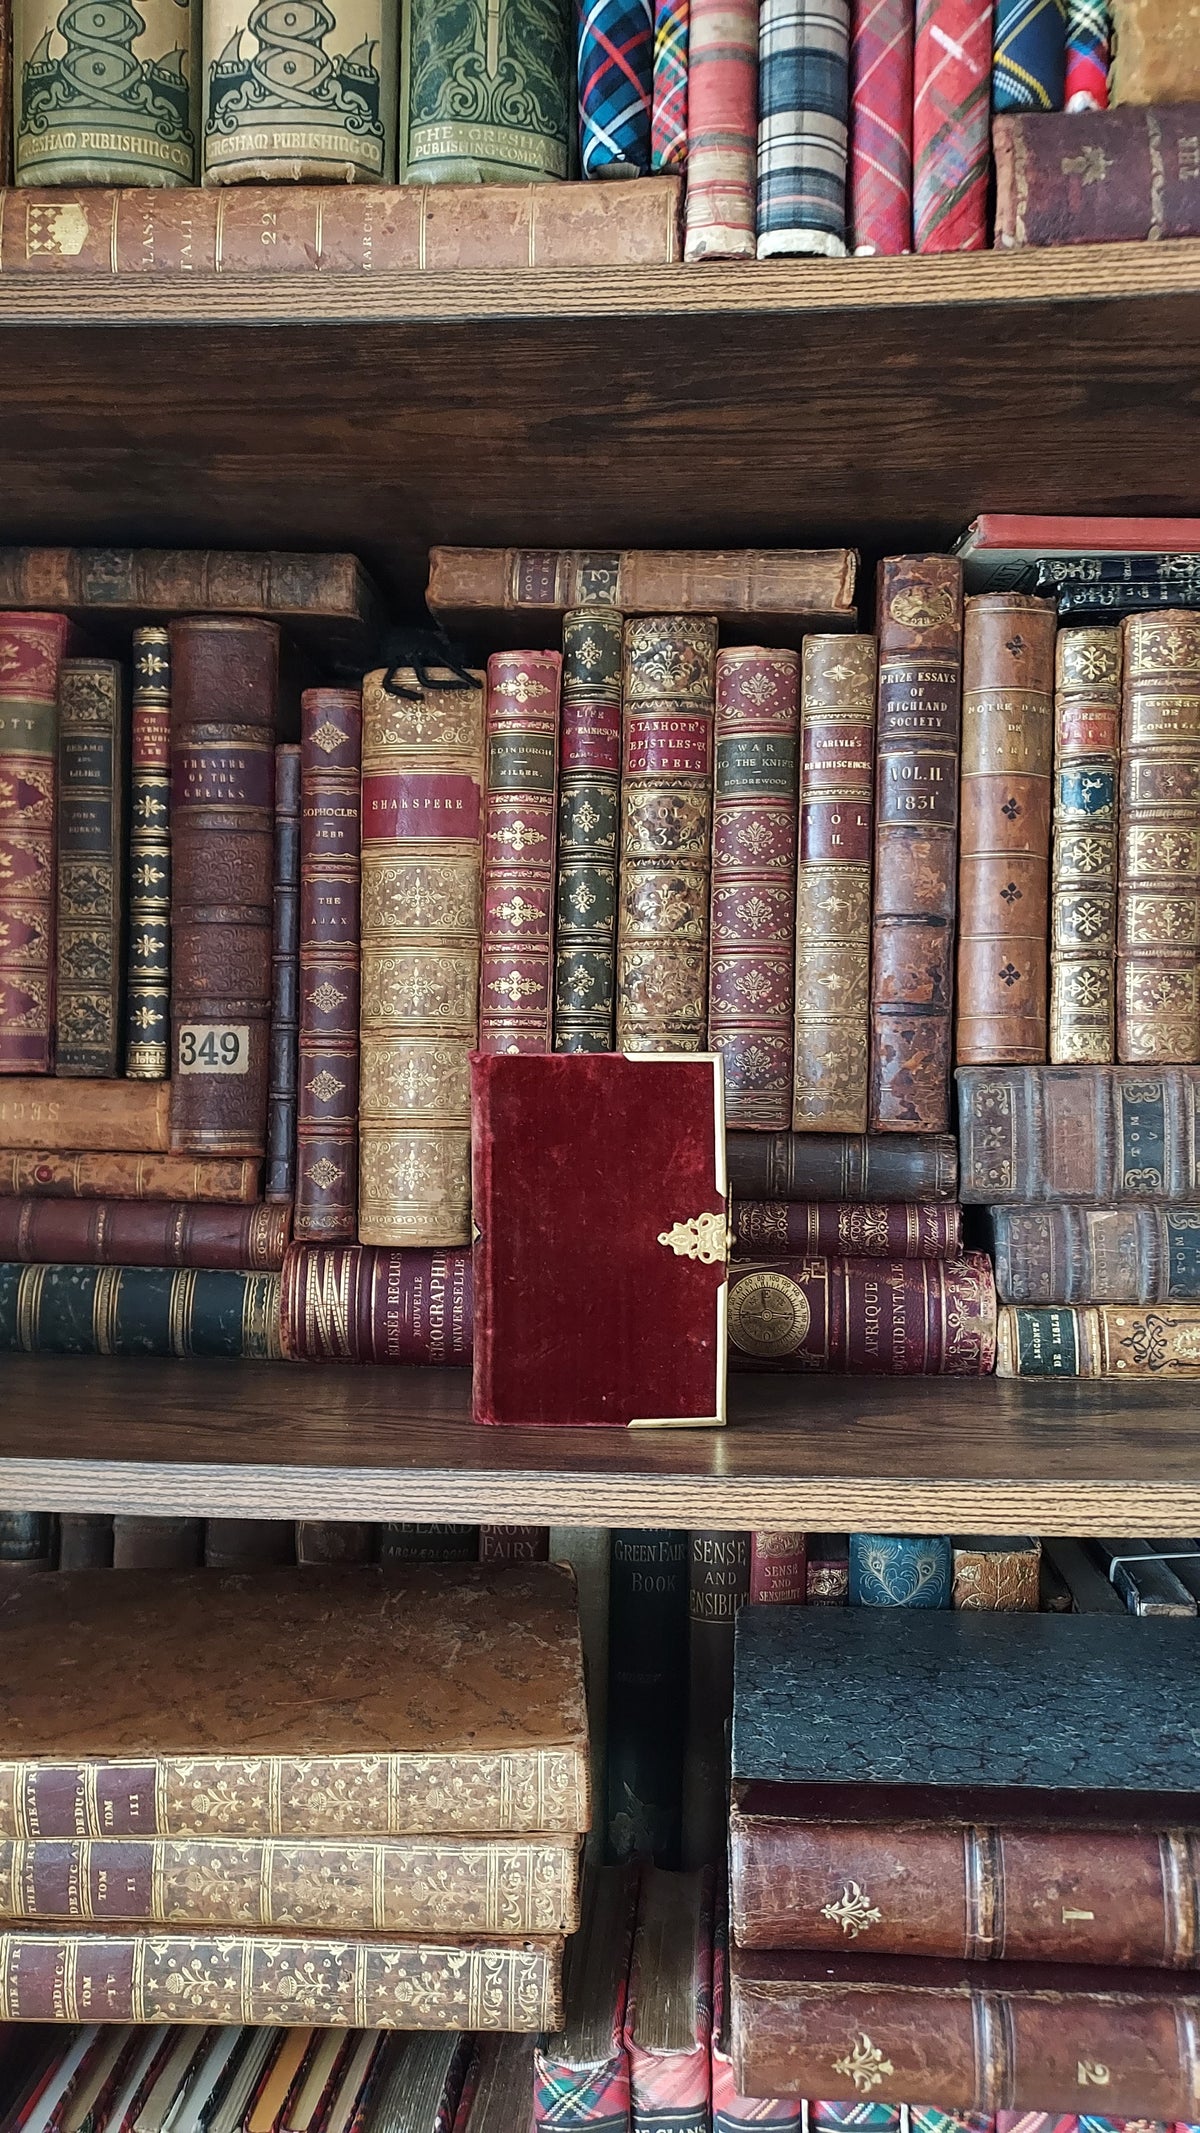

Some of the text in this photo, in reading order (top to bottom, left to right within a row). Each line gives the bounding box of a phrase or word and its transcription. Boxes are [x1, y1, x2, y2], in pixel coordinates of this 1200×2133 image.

[414, 126, 453, 144] THE
[81, 132, 170, 158] PUBLISHING
[272, 132, 361, 154] PUBLISHING
[415, 140, 496, 157] PUBLISHING
[590, 569, 610, 583] 3
[881, 672, 956, 684] PRIZE ESSAYS
[910, 687, 923, 697] OF
[887, 702, 948, 713] HIGHLAND
[968, 702, 1013, 714] NOTRE
[630, 721, 706, 735] STANHOPE'S
[889, 717, 942, 727] SOCIETY
[1008, 724, 1022, 732] DE
[737, 743, 775, 752] WAR
[816, 737, 862, 748] CARLYLE'S
[184, 758, 245, 769] THEATRE
[629, 757, 702, 769] GOSPELS
[735, 758, 757, 767] THE
[211, 773, 235, 783] THE
[724, 778, 787, 786] BOLDREWOOD
[184, 788, 245, 798] GREEKS
[372, 798, 464, 810] SHAKSPERE
[895, 795, 936, 810] 1831
[303, 807, 358, 818] SOPHOCLES
[315, 830, 344, 839] JEBB
[317, 897, 341, 905] THE
[310, 917, 348, 926] AJAX
[180, 1030, 241, 1066] 349
[1130, 1115, 1141, 1158] TOM
[1174, 1236, 1186, 1274] TOM
[384, 1252, 402, 1356] ÉLISÉE RECLUS
[413, 1276, 423, 1337] NOUVELLE
[452, 1258, 465, 1352] UNIVERSELLE
[864, 1282, 881, 1356] AFRIQUE
[1032, 1322, 1042, 1359] LECONTE
[1050, 1314, 1062, 1367] DE LISLE
[484, 1536, 540, 1558] FAIRY
[614, 1539, 658, 1563] GREEN
[693, 1539, 747, 1566] SENSE
[704, 1571, 737, 1585] AND
[764, 1564, 798, 1577] SENSE
[632, 1573, 677, 1592] BOOK
[770, 1579, 791, 1588] AND
[129, 1793, 139, 1816] III
[103, 1799, 114, 1827] TOM
[97, 1869, 108, 1901] TOM
[126, 1877, 136, 1892] II
[1062, 1906, 1095, 1924] 1
[82, 1975, 92, 2008] TOM
[1077, 2060, 1110, 2086] 2
